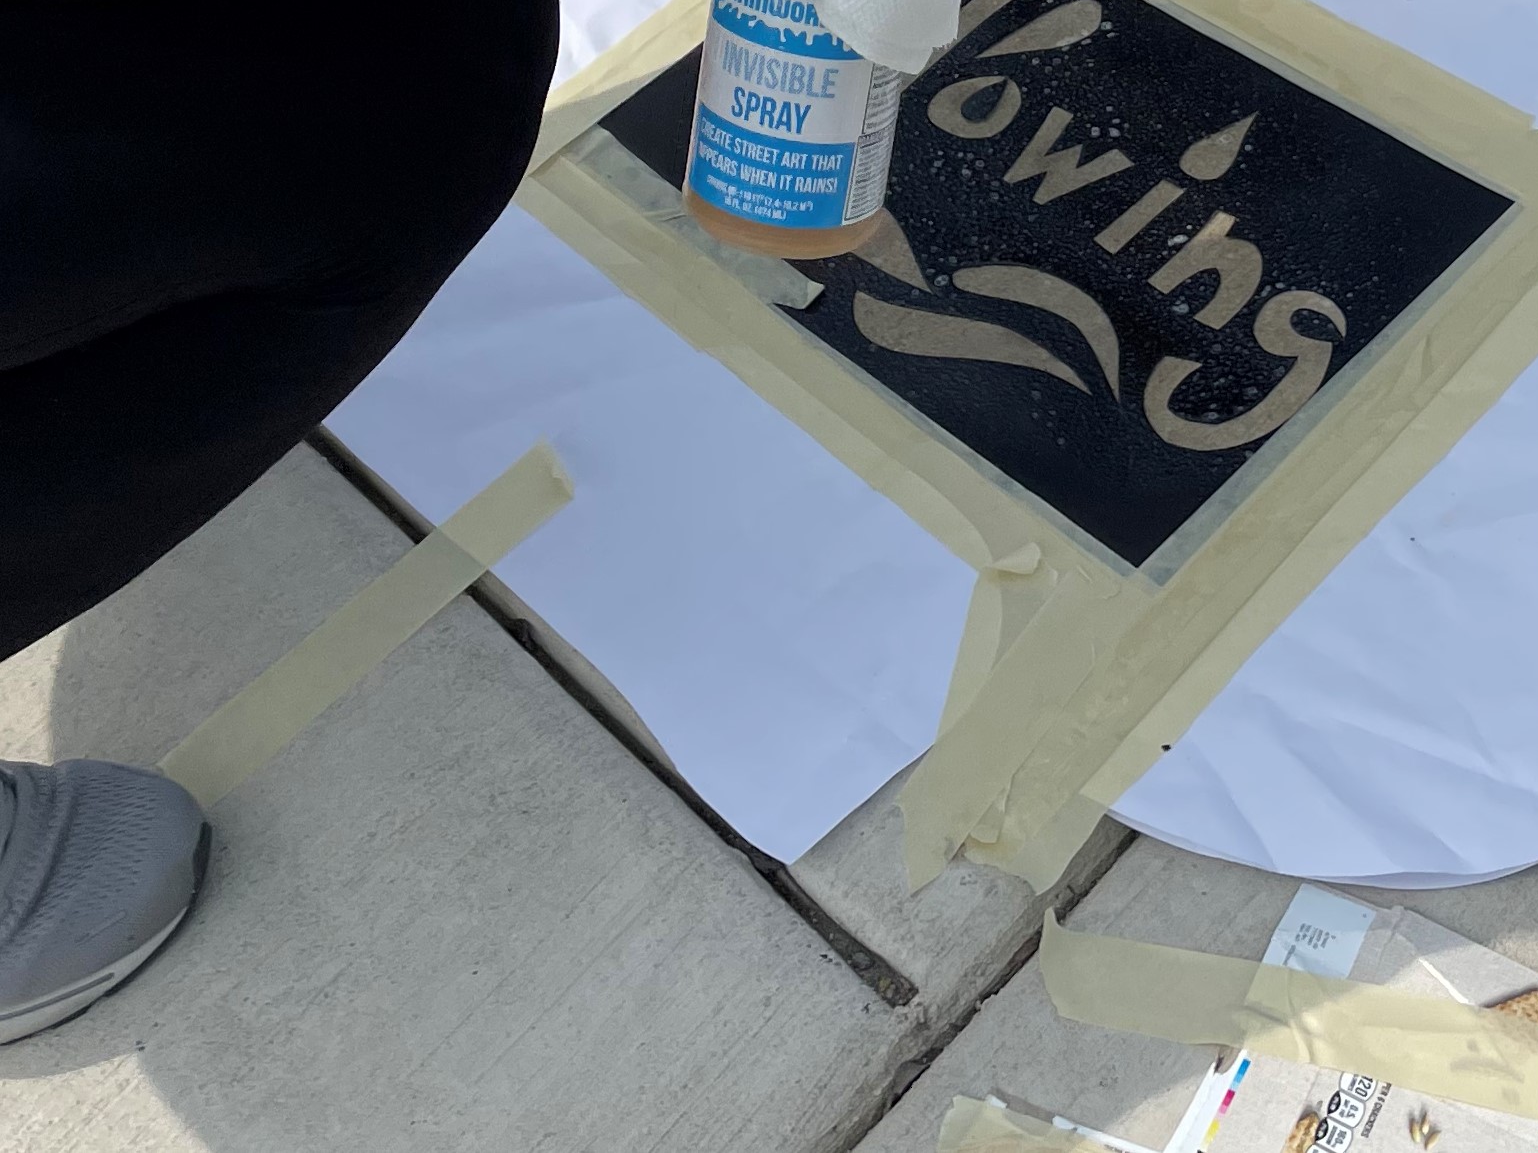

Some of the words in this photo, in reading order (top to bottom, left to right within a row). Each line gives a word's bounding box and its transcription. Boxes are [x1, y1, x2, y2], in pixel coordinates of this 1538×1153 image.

[722, 40, 839, 98] INVISIBLE
[731, 86, 811, 134] SPRAY
[734, 138, 779, 165] STREET
[781, 152, 808, 169] ART
[811, 154, 843, 170] THAT
[740, 164, 777, 188] WHEN
[780, 174, 793, 191] IT
[795, 177, 837, 193] RAINS!
